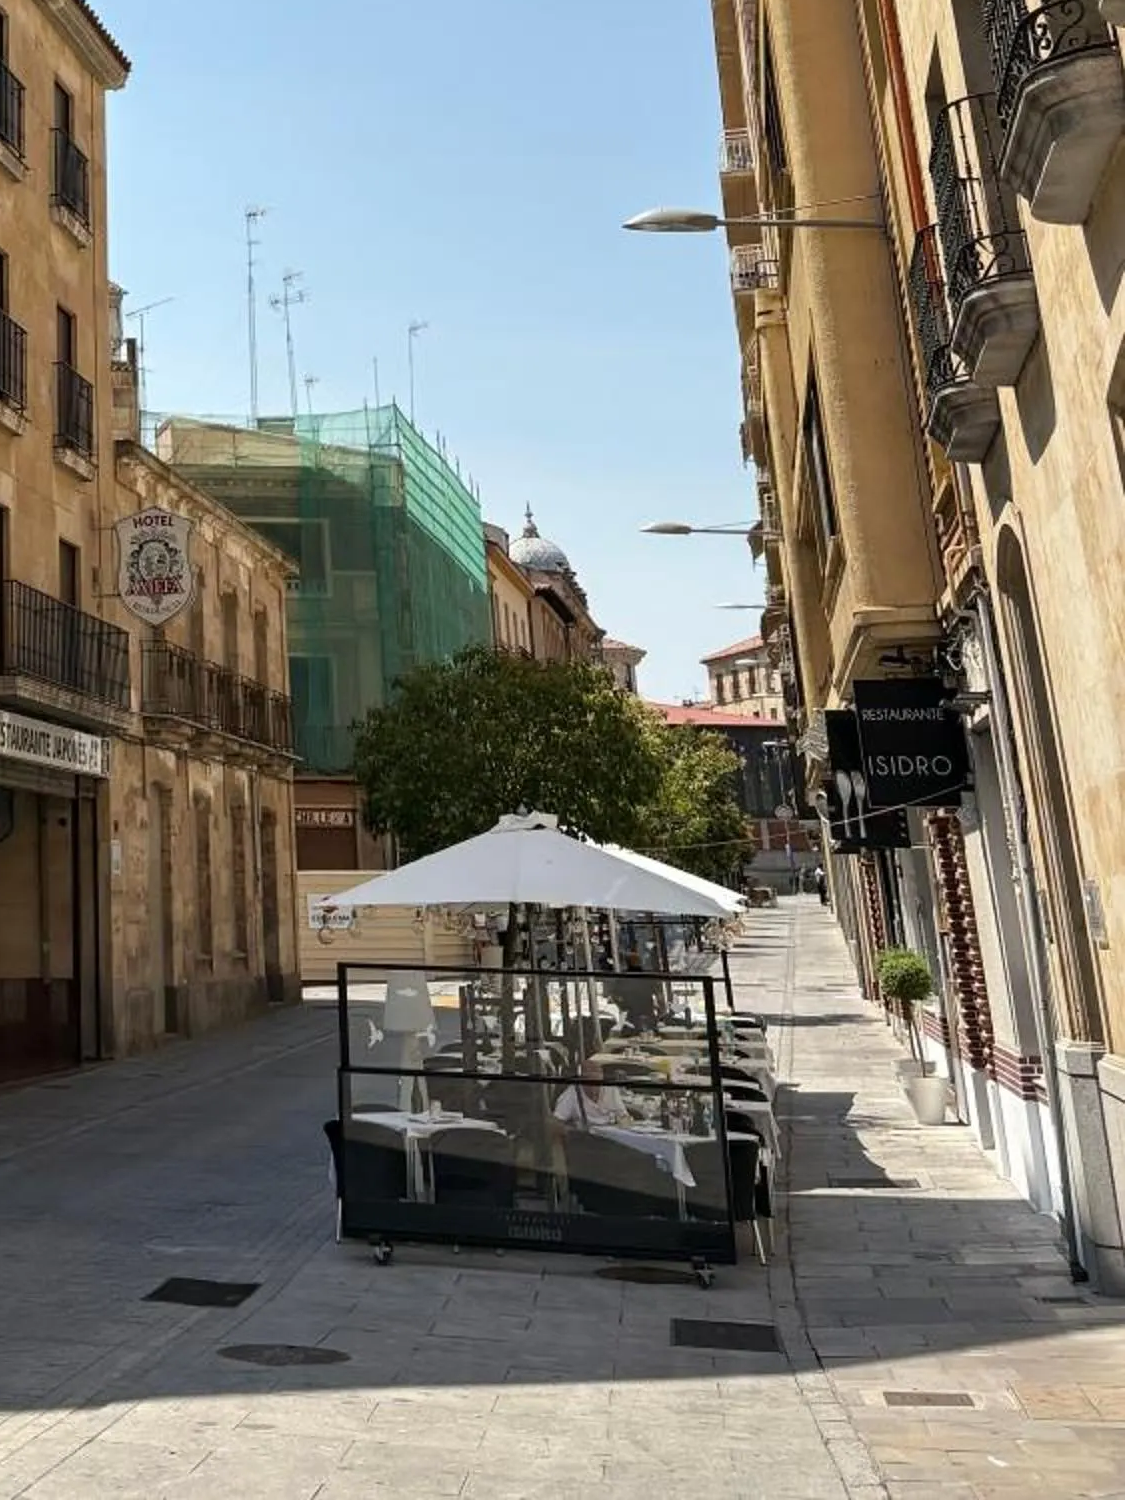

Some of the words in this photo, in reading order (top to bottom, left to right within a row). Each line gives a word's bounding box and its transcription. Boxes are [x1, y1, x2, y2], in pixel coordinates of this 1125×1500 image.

[133, 515, 174, 528] HOTEL
[862, 707, 945, 722] RESTAURANTE
[868, 755, 952, 777] ISIDRO
